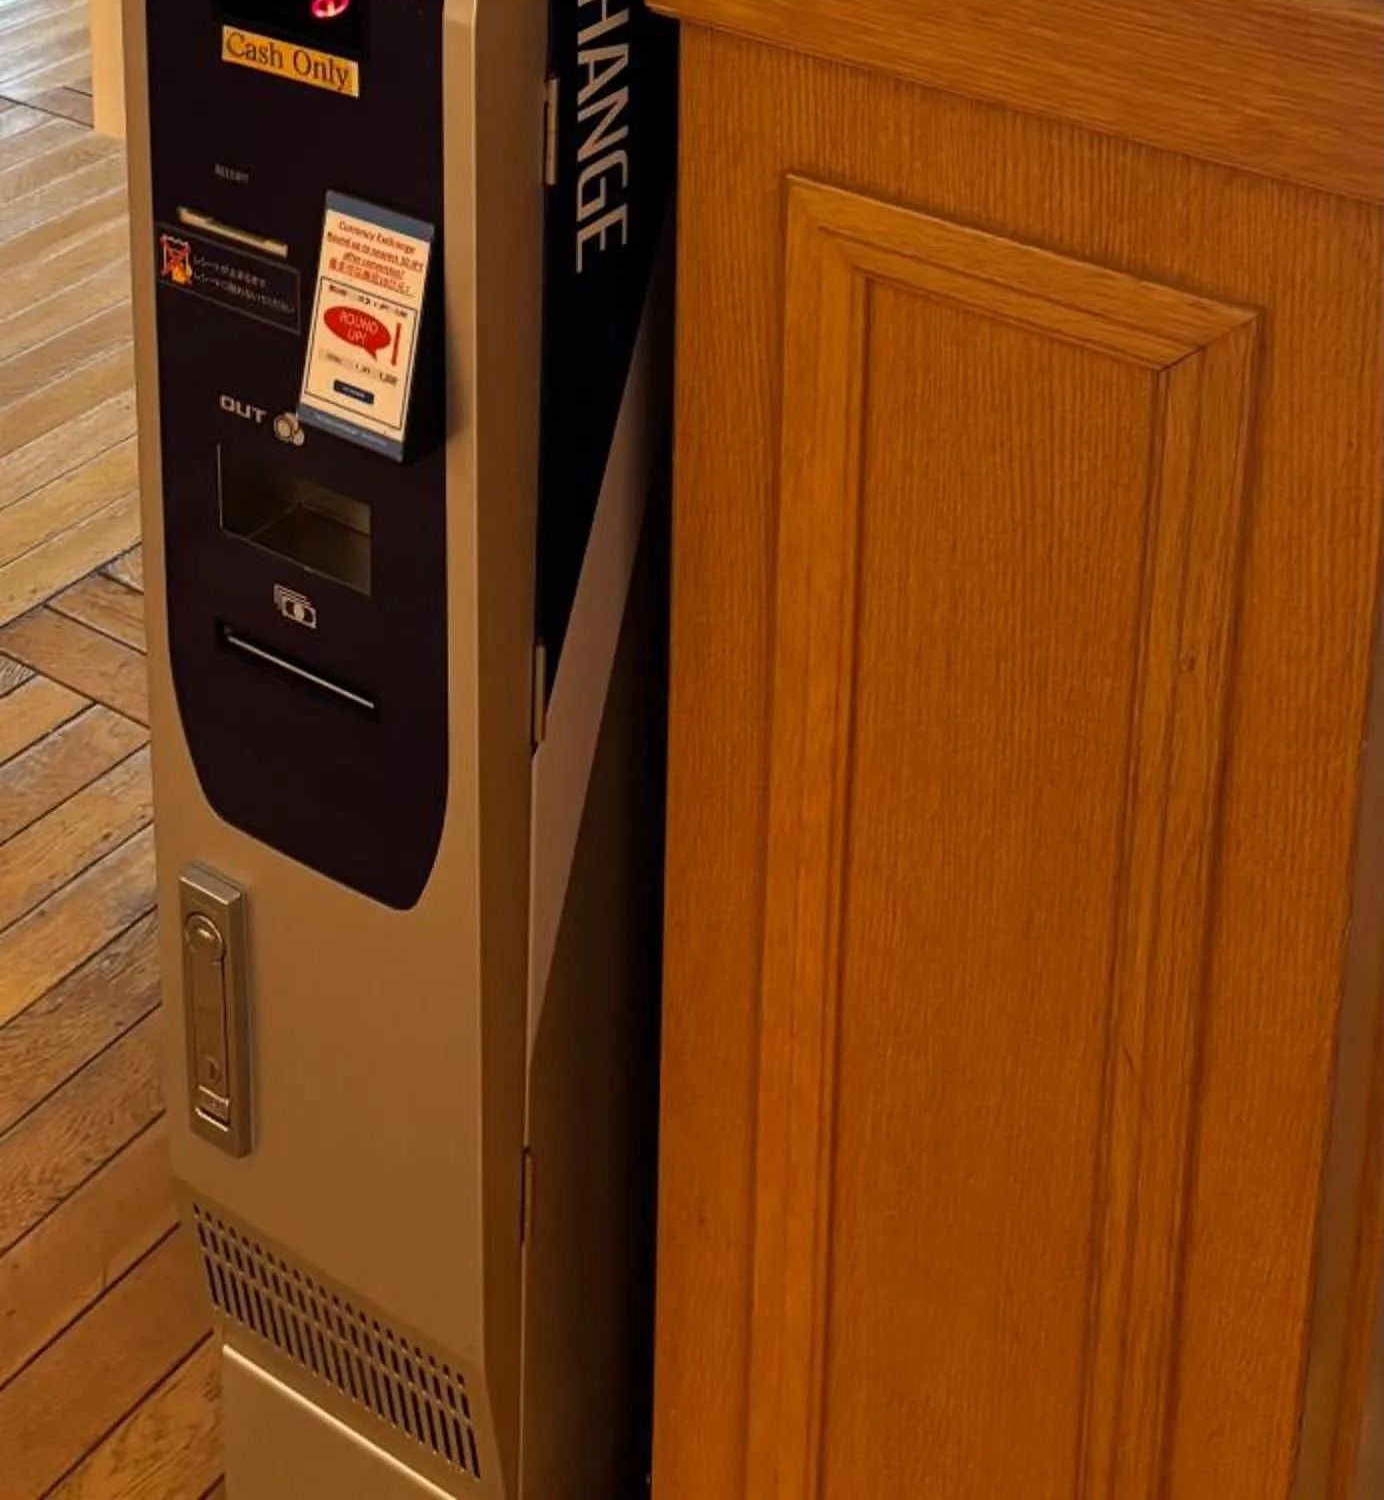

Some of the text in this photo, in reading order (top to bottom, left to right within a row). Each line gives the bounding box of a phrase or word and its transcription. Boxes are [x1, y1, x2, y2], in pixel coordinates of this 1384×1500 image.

[225, 31, 349, 90] Cash Only
[220, 395, 268, 424] OUT
